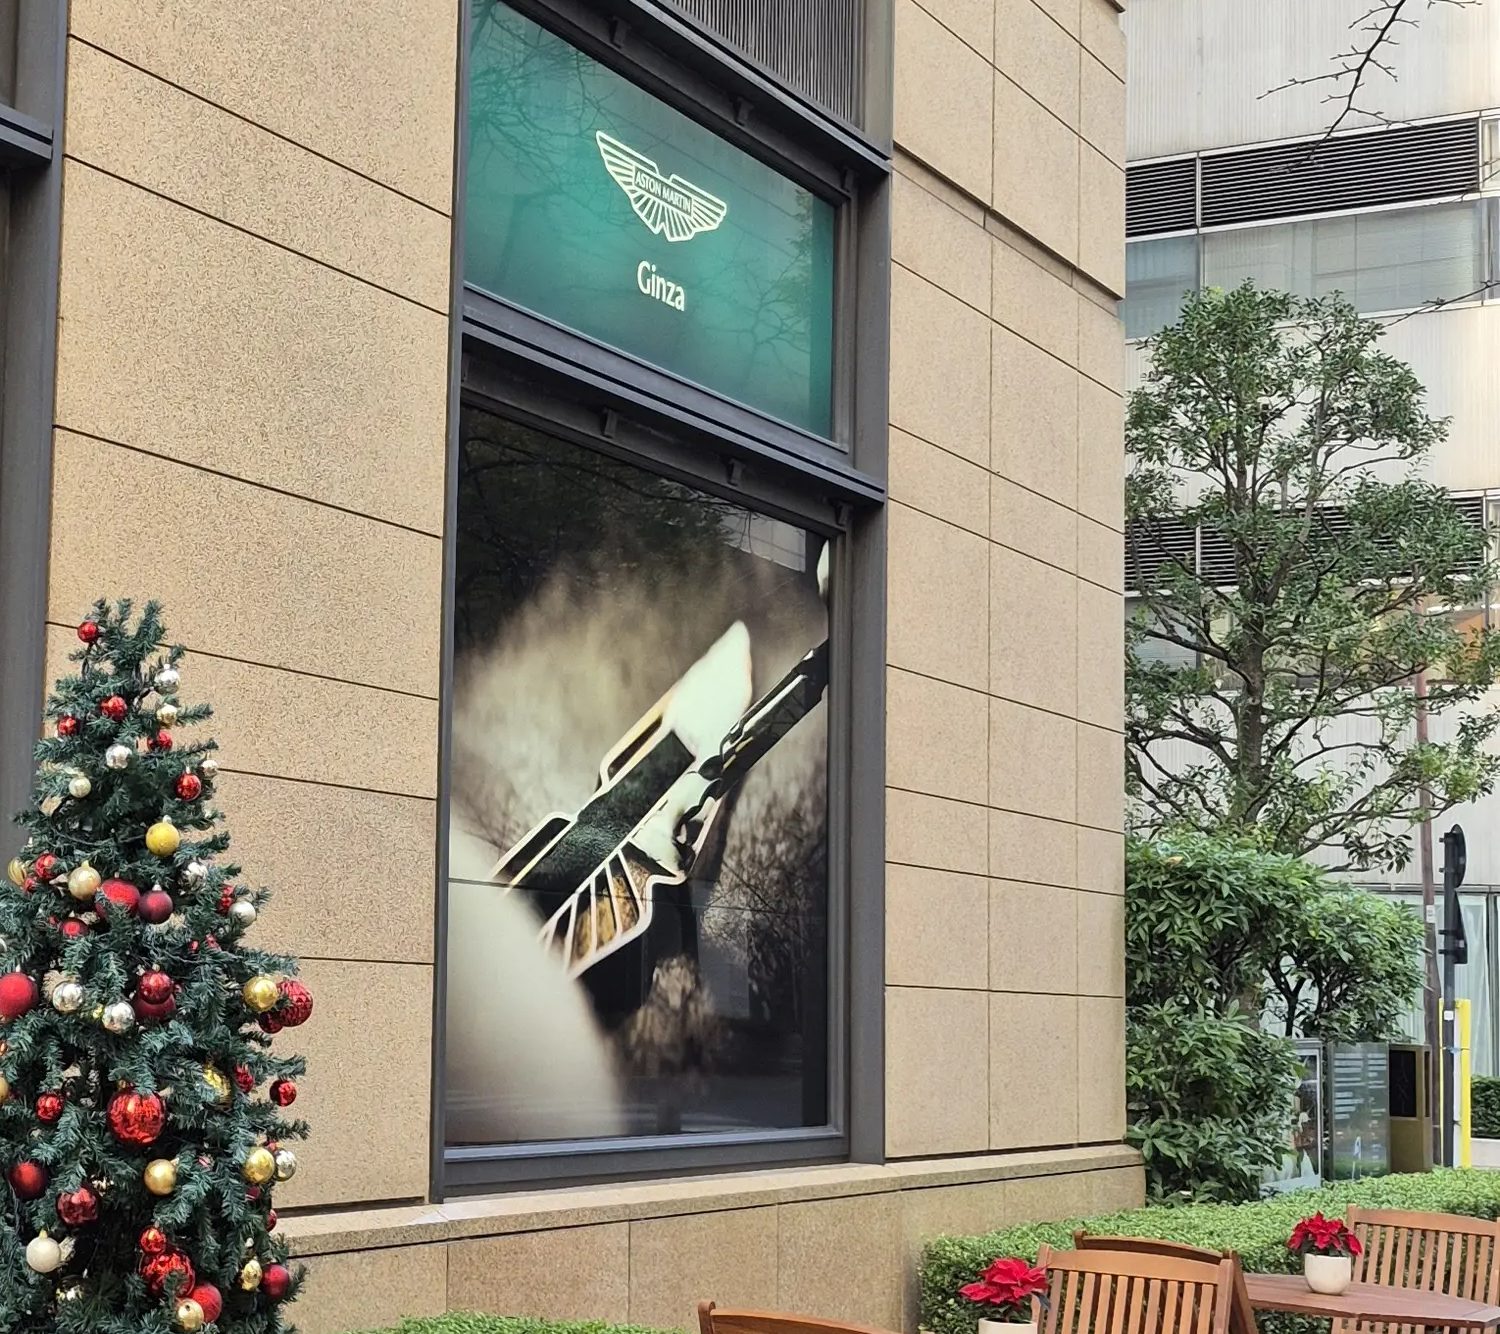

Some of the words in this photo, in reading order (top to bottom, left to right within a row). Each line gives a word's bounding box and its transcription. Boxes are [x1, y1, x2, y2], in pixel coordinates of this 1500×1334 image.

[634, 170, 662, 197] ASTON
[662, 185, 692, 213] MARTIN
[636, 260, 685, 312] Ginza
